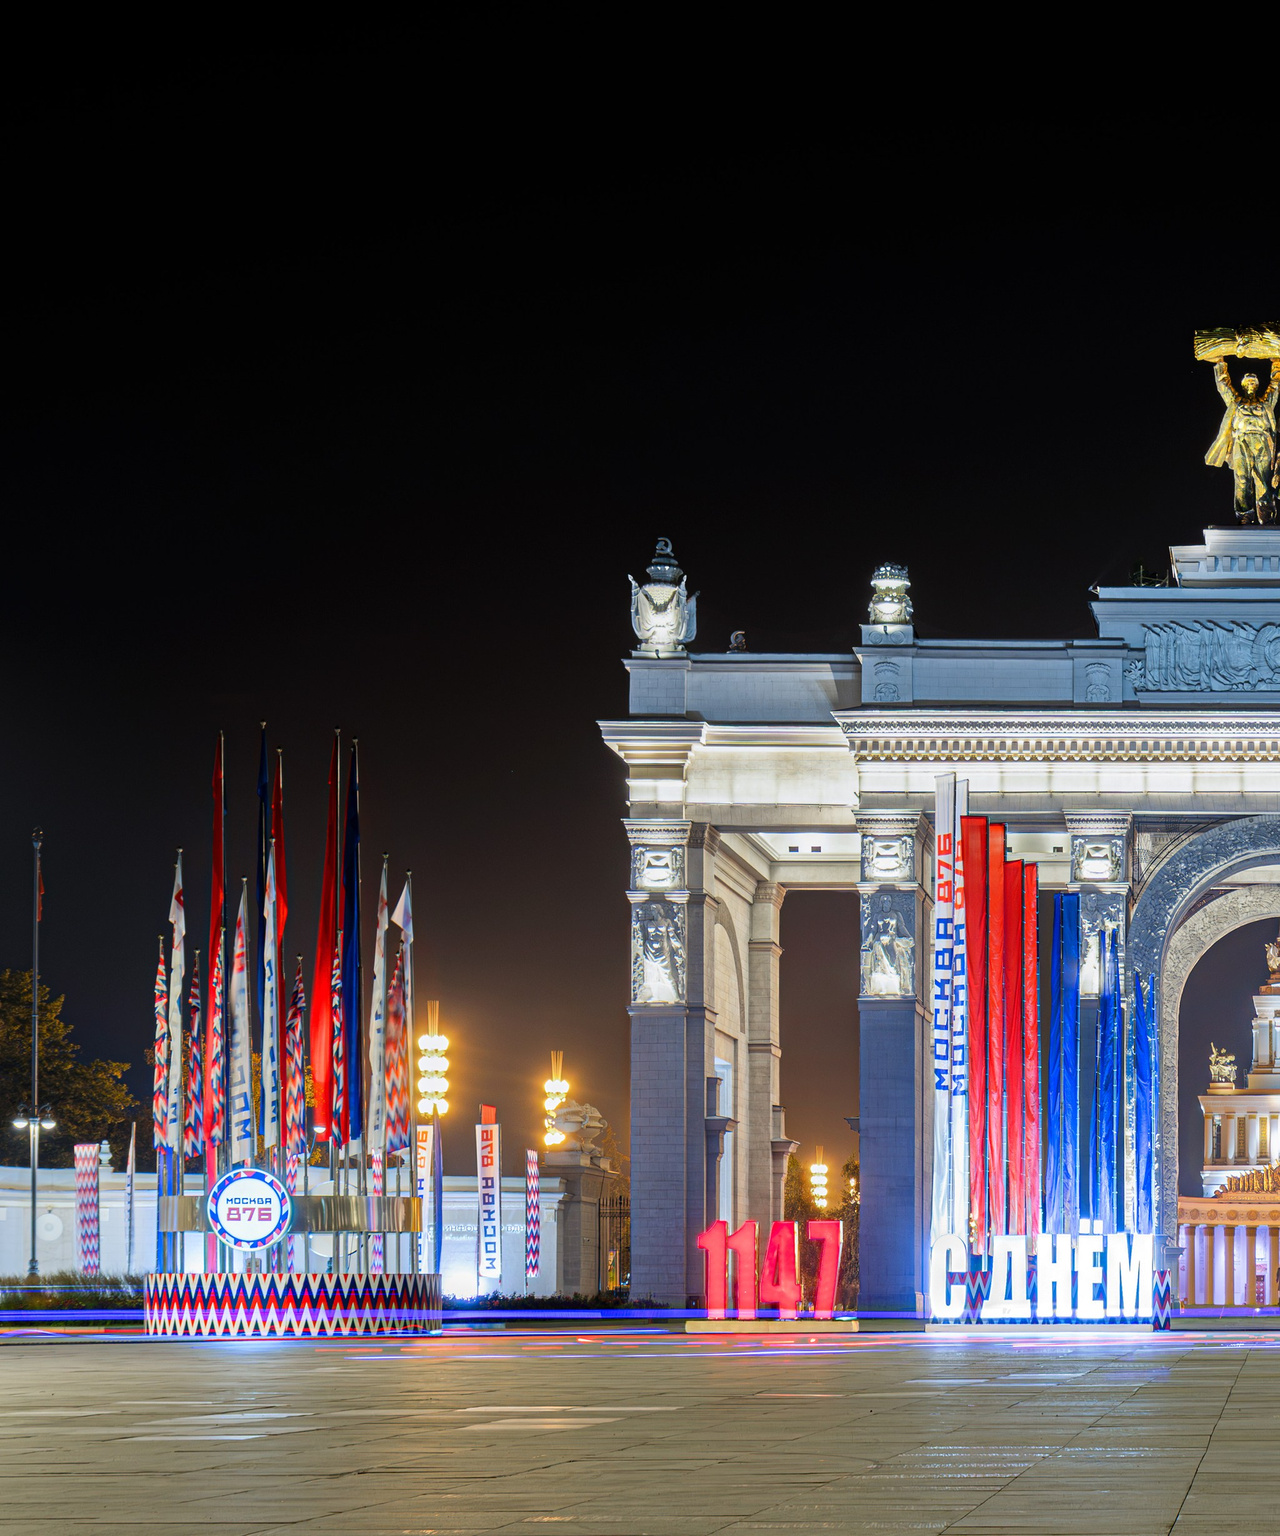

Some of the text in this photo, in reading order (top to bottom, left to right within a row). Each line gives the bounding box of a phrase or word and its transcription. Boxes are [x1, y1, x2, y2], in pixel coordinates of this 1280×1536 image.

[934, 833, 953, 1091] МОСКВА 876
[226, 1197, 272, 1205] МОСКВА
[226, 1207, 272, 1222] 876
[697, 1220, 844, 1320] 1147
[930, 1218, 1153, 1319] С ДНЁМ
